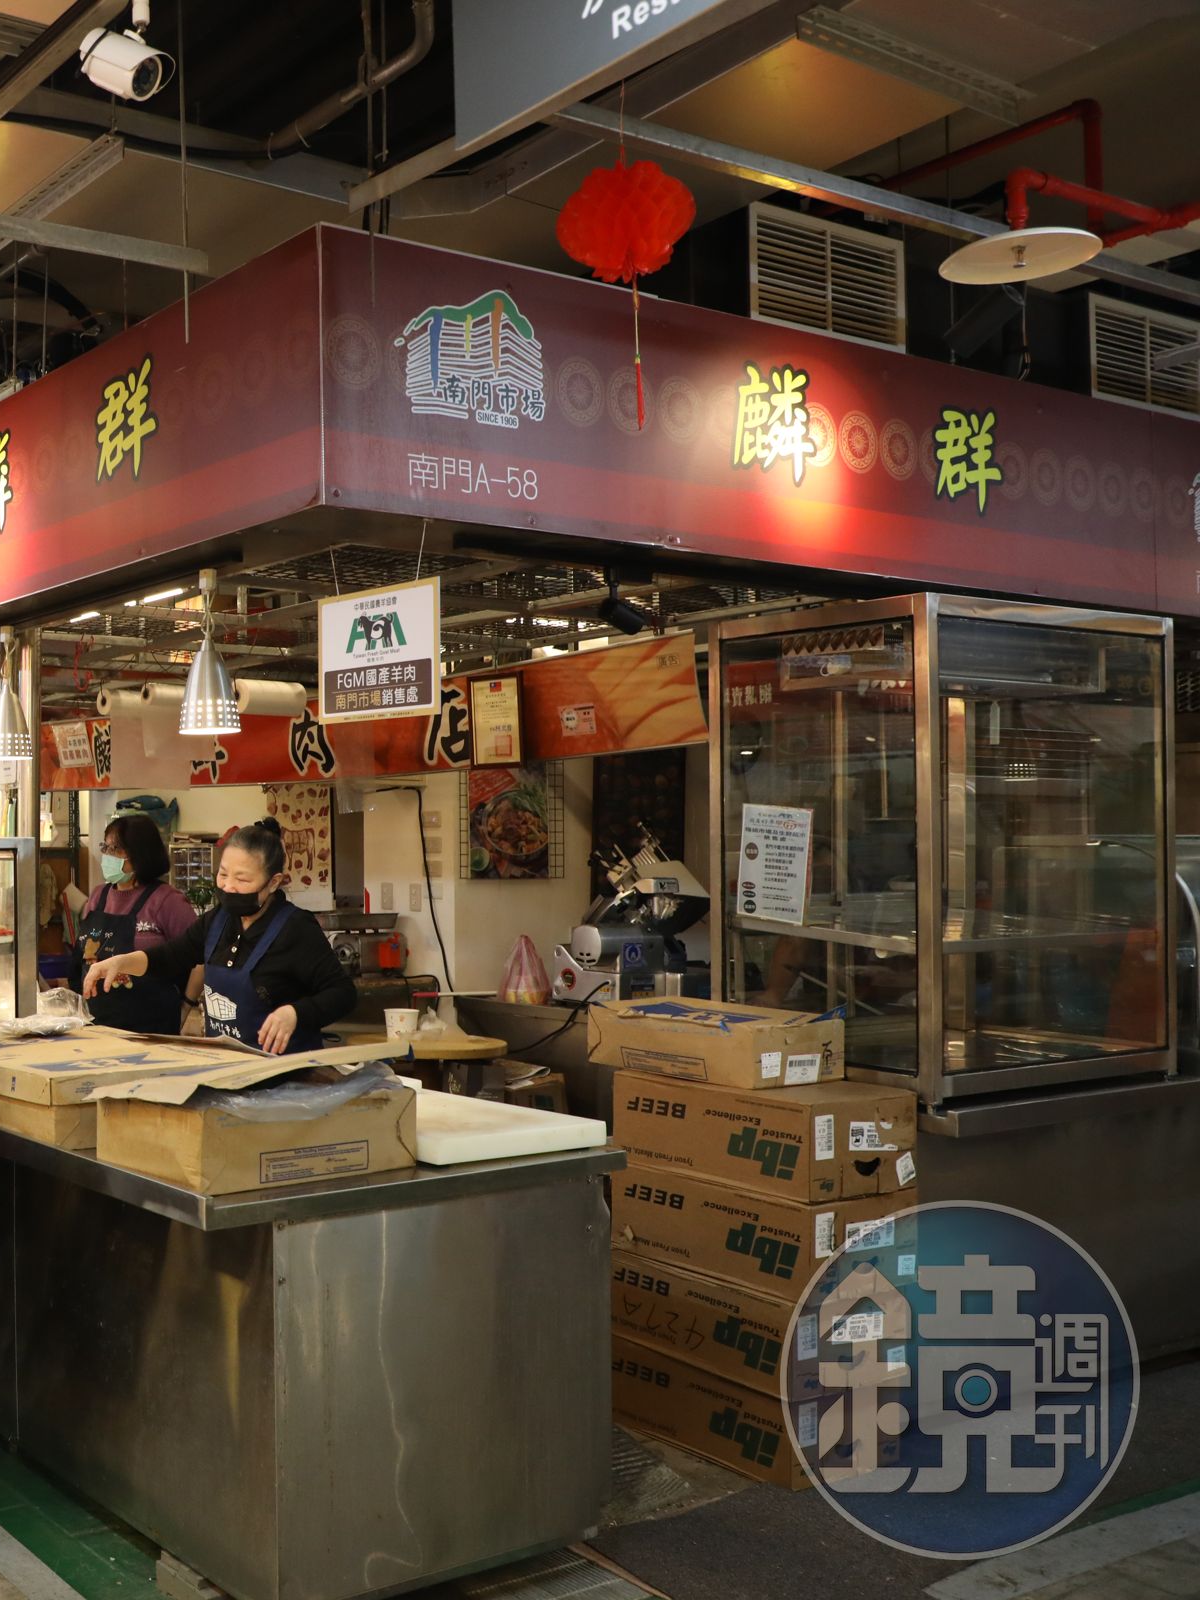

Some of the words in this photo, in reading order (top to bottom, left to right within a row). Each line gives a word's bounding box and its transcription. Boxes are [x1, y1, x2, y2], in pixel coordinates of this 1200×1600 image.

[611, 0, 681, 40] Res
[441, 375, 545, 421] 南門市場
[476, 410, 500, 425] SINCE
[500, 414, 519, 428] 1906
[407, 452, 539, 501] 南門A-58
[337, 664, 416, 690] FGM國產羊肉
[335, 686, 419, 711] 南門市場銷售處
[627, 1096, 687, 1120] BEEF
[705, 1108, 761, 1127] Excellence
[762, 1127, 804, 1144] Trusted
[654, 1152, 673, 1163] Fresh
[674, 1156, 694, 1167] Tyson
[726, 1126, 800, 1181] ibp
[624, 1183, 685, 1210] BEEF
[703, 1200, 760, 1222] Excellence
[760, 1224, 802, 1243] Trusted
[651, 1241, 670, 1253] Fresh
[671, 1246, 691, 1258] Tyson
[725, 1221, 800, 1280] ibp
[613, 1267, 671, 1298] BEEF
[687, 1288, 740, 1315] Excellence
[739, 1316, 782, 1339] Trusted
[712, 1314, 782, 1377] ibp
[612, 1357, 671, 1390] BEEF
[686, 1381, 743, 1409] Excellence
[743, 1411, 784, 1433] Trusted
[708, 1406, 780, 1469] ibp
